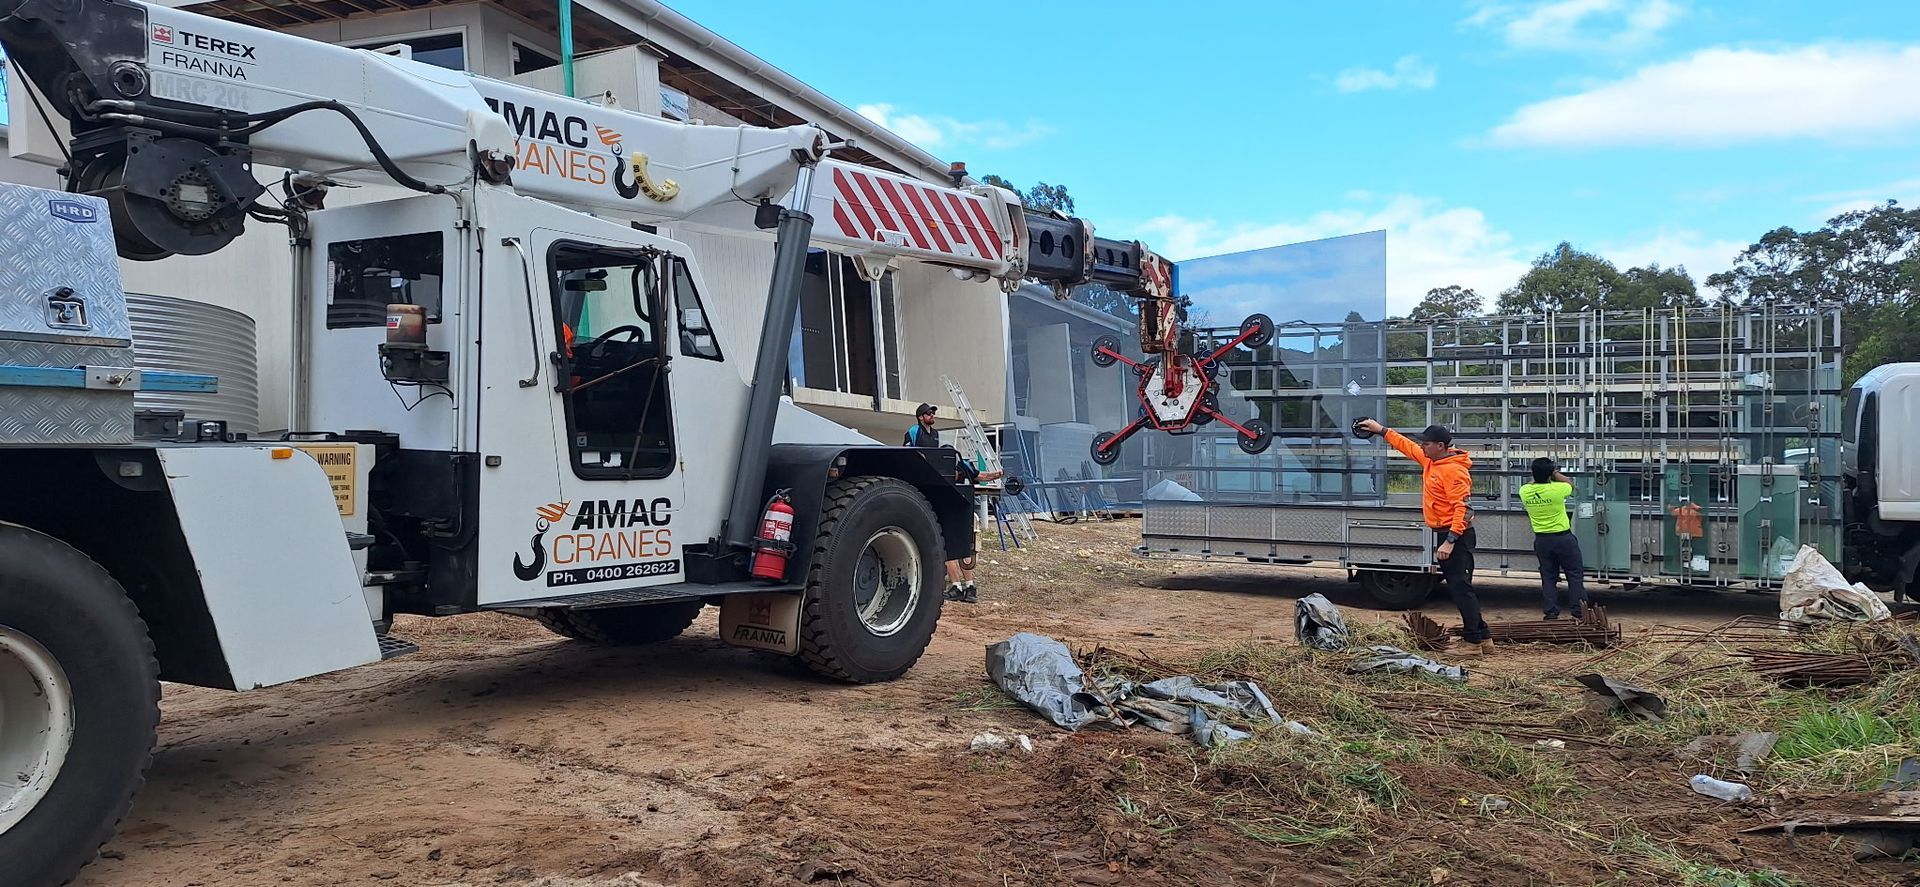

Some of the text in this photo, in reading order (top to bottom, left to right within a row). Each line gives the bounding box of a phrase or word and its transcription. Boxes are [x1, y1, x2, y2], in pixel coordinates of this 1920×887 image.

[179, 31, 256, 60] TEREX
[163, 51, 247, 80] FRANNA
[155, 73, 207, 102] MRC
[55, 203, 93, 218] HRD
[317, 452, 351, 465] WARNING
[571, 497, 671, 530] AMAC
[553, 529, 672, 564] CRANES
[553, 562, 675, 584] Ph. 0400 262622
[733, 624, 786, 647] FRANNA
